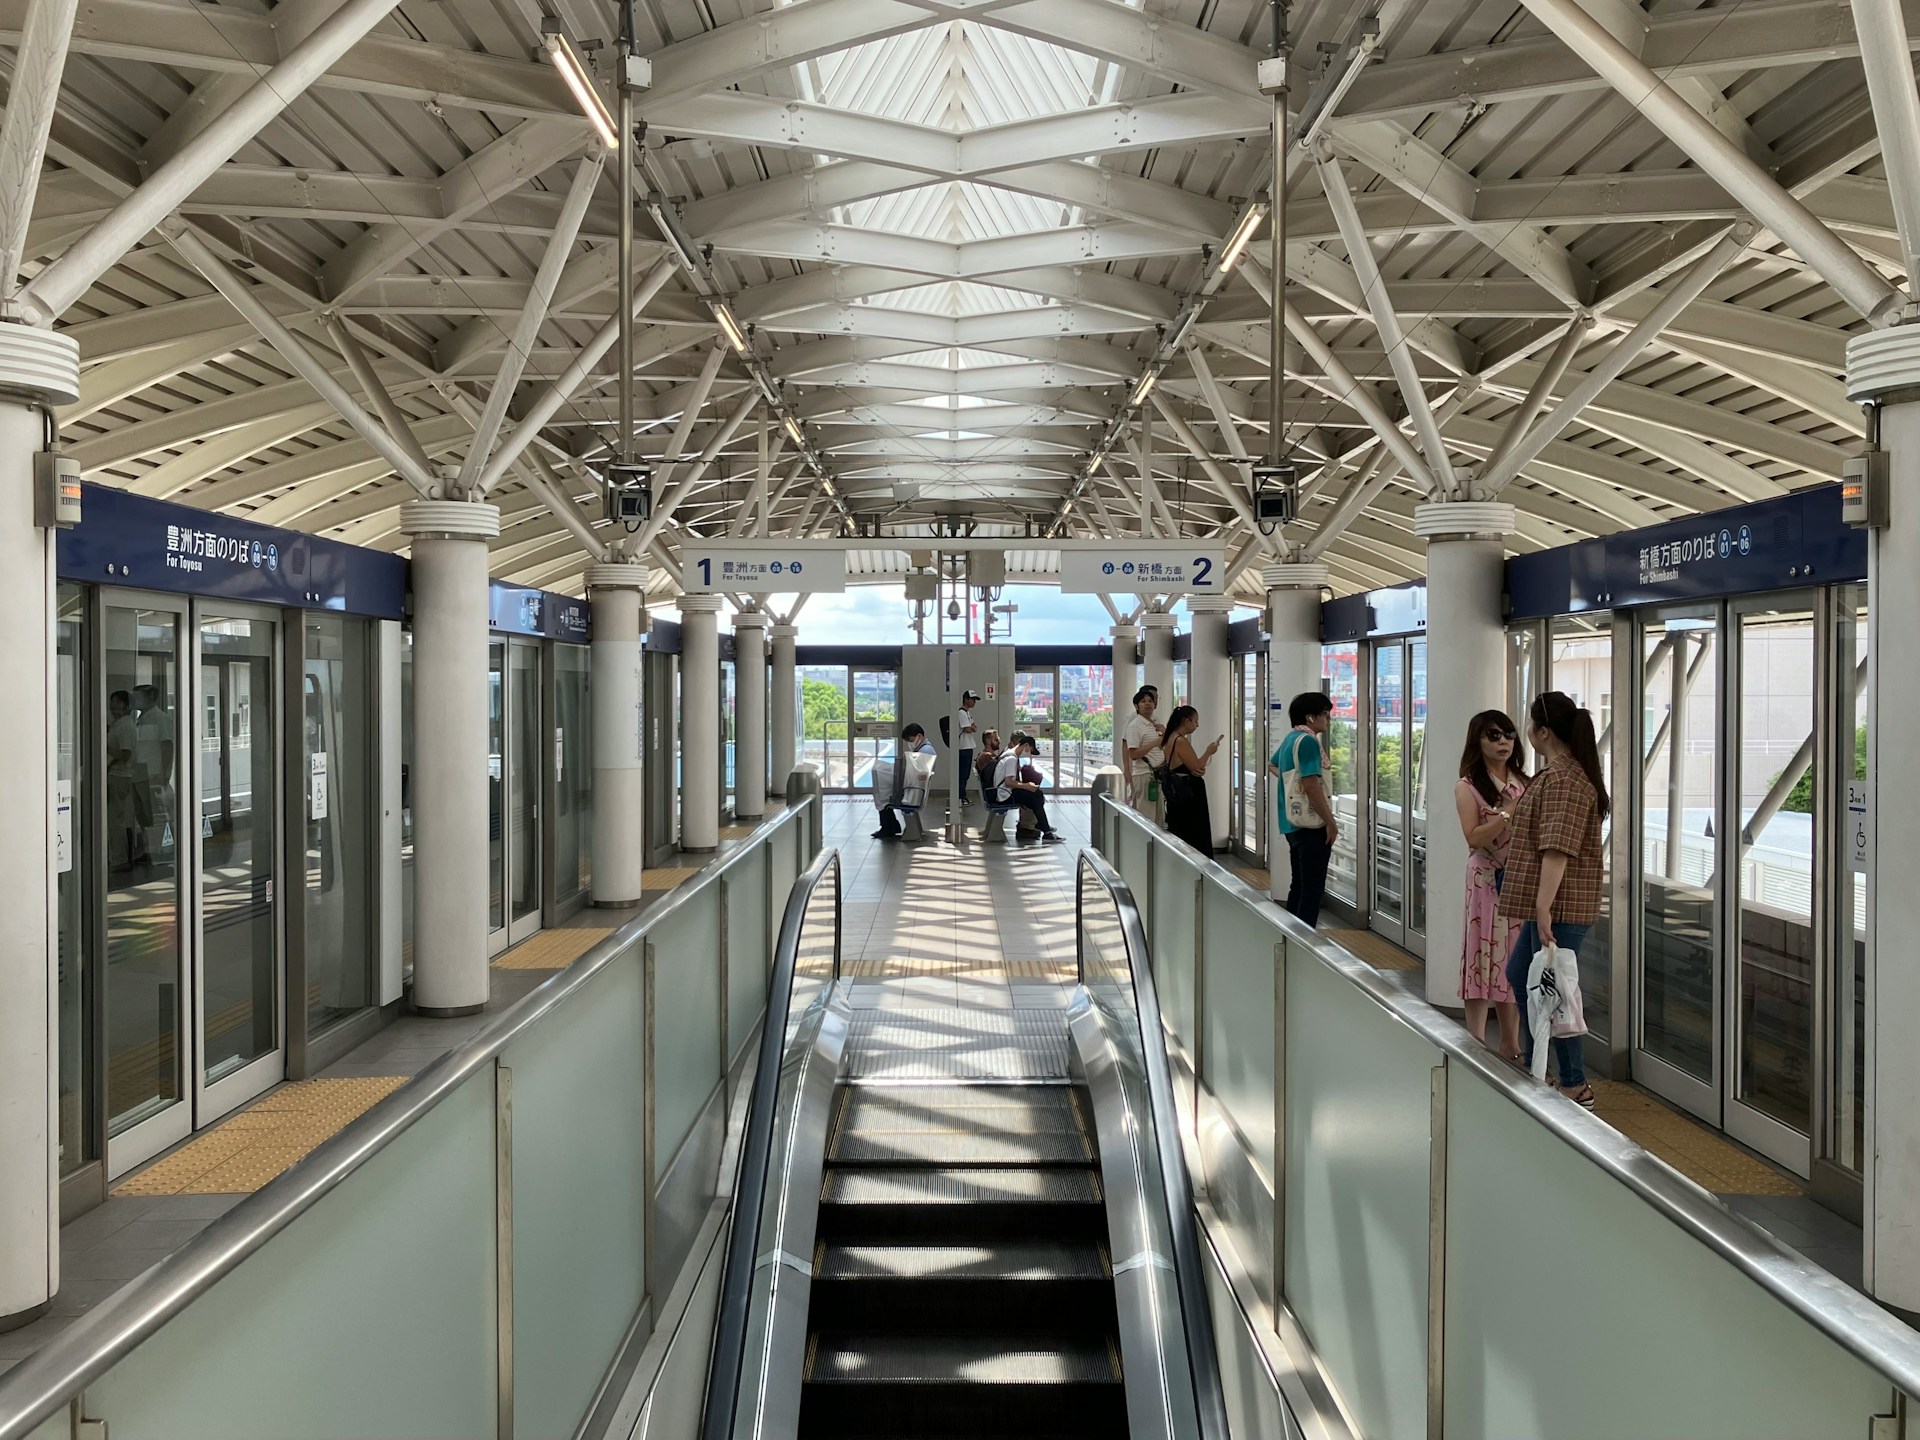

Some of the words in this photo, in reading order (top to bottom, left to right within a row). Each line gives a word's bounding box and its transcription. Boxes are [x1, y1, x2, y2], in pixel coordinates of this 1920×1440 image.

[167, 525, 249, 563] 豊洲方面のりば
[1640, 533, 1715, 570] 新橋方面のりば
[1721, 541, 1728, 553] 01
[1740, 538, 1749, 550] 06
[167, 553, 177, 568] For
[179, 555, 202, 572] Toyosu
[697, 558, 710, 585] 1
[1192, 557, 1212, 585] 2
[1640, 573, 1648, 584] For
[1650, 567, 1678, 583] Shimbashi
